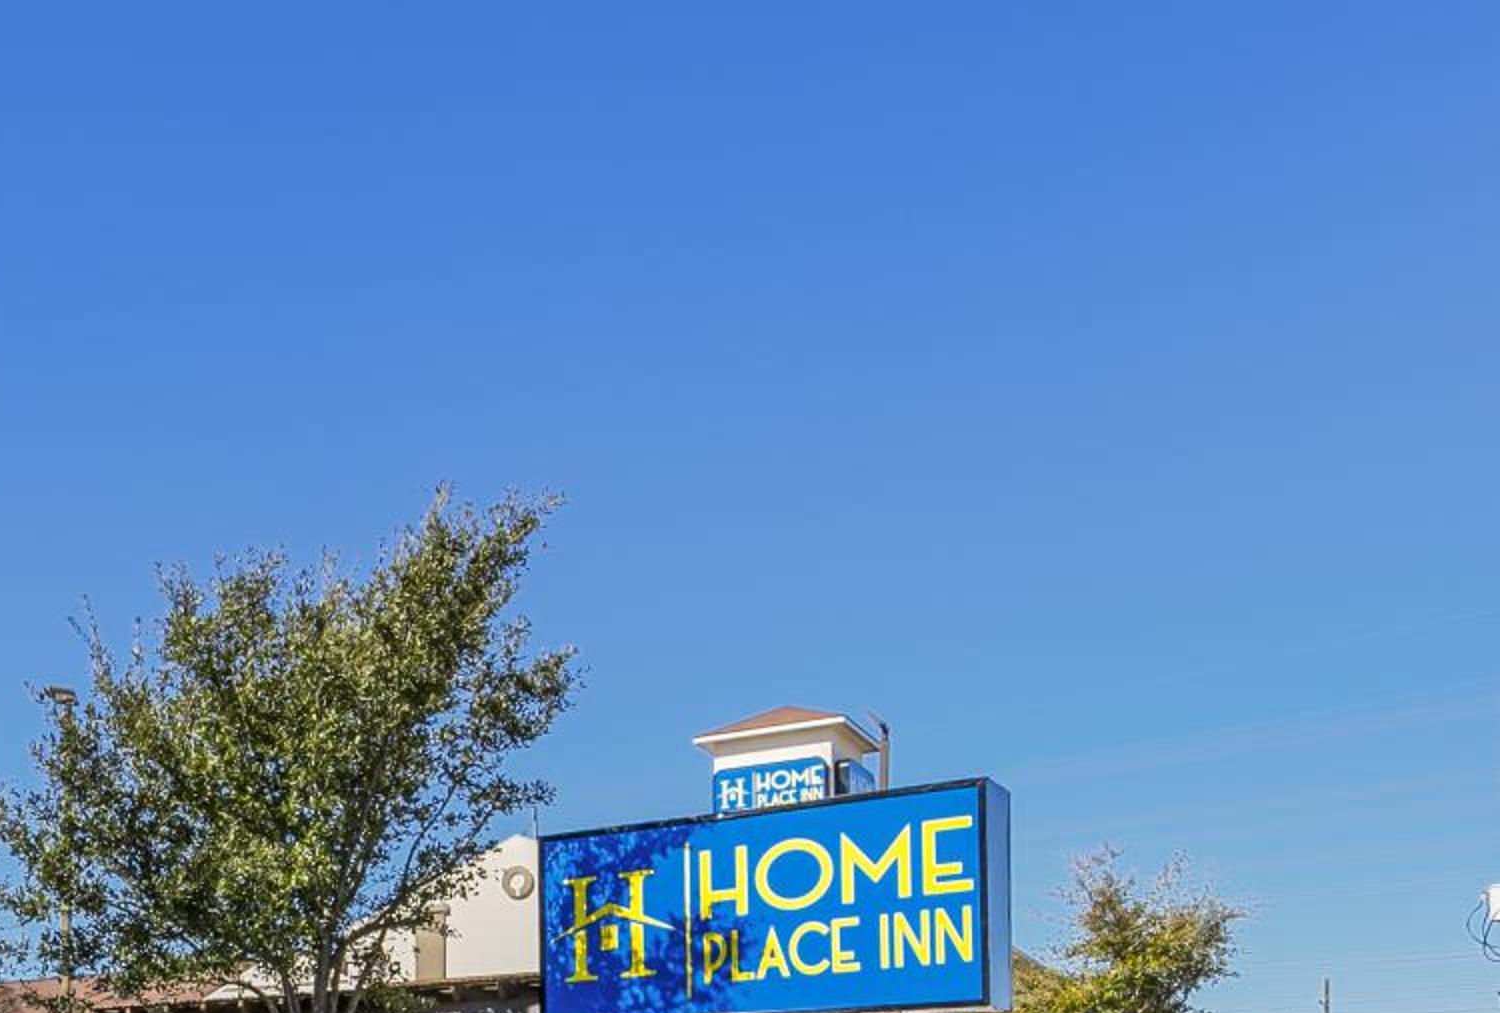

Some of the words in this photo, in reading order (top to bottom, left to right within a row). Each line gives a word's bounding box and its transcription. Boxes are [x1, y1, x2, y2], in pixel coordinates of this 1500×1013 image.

[756, 765, 824, 791] HOME
[757, 790, 798, 807] PLACE
[800, 785, 823, 803] INN
[699, 815, 975, 920] HOME
[702, 916, 861, 986] PLACE
[879, 904, 974, 970] INN
